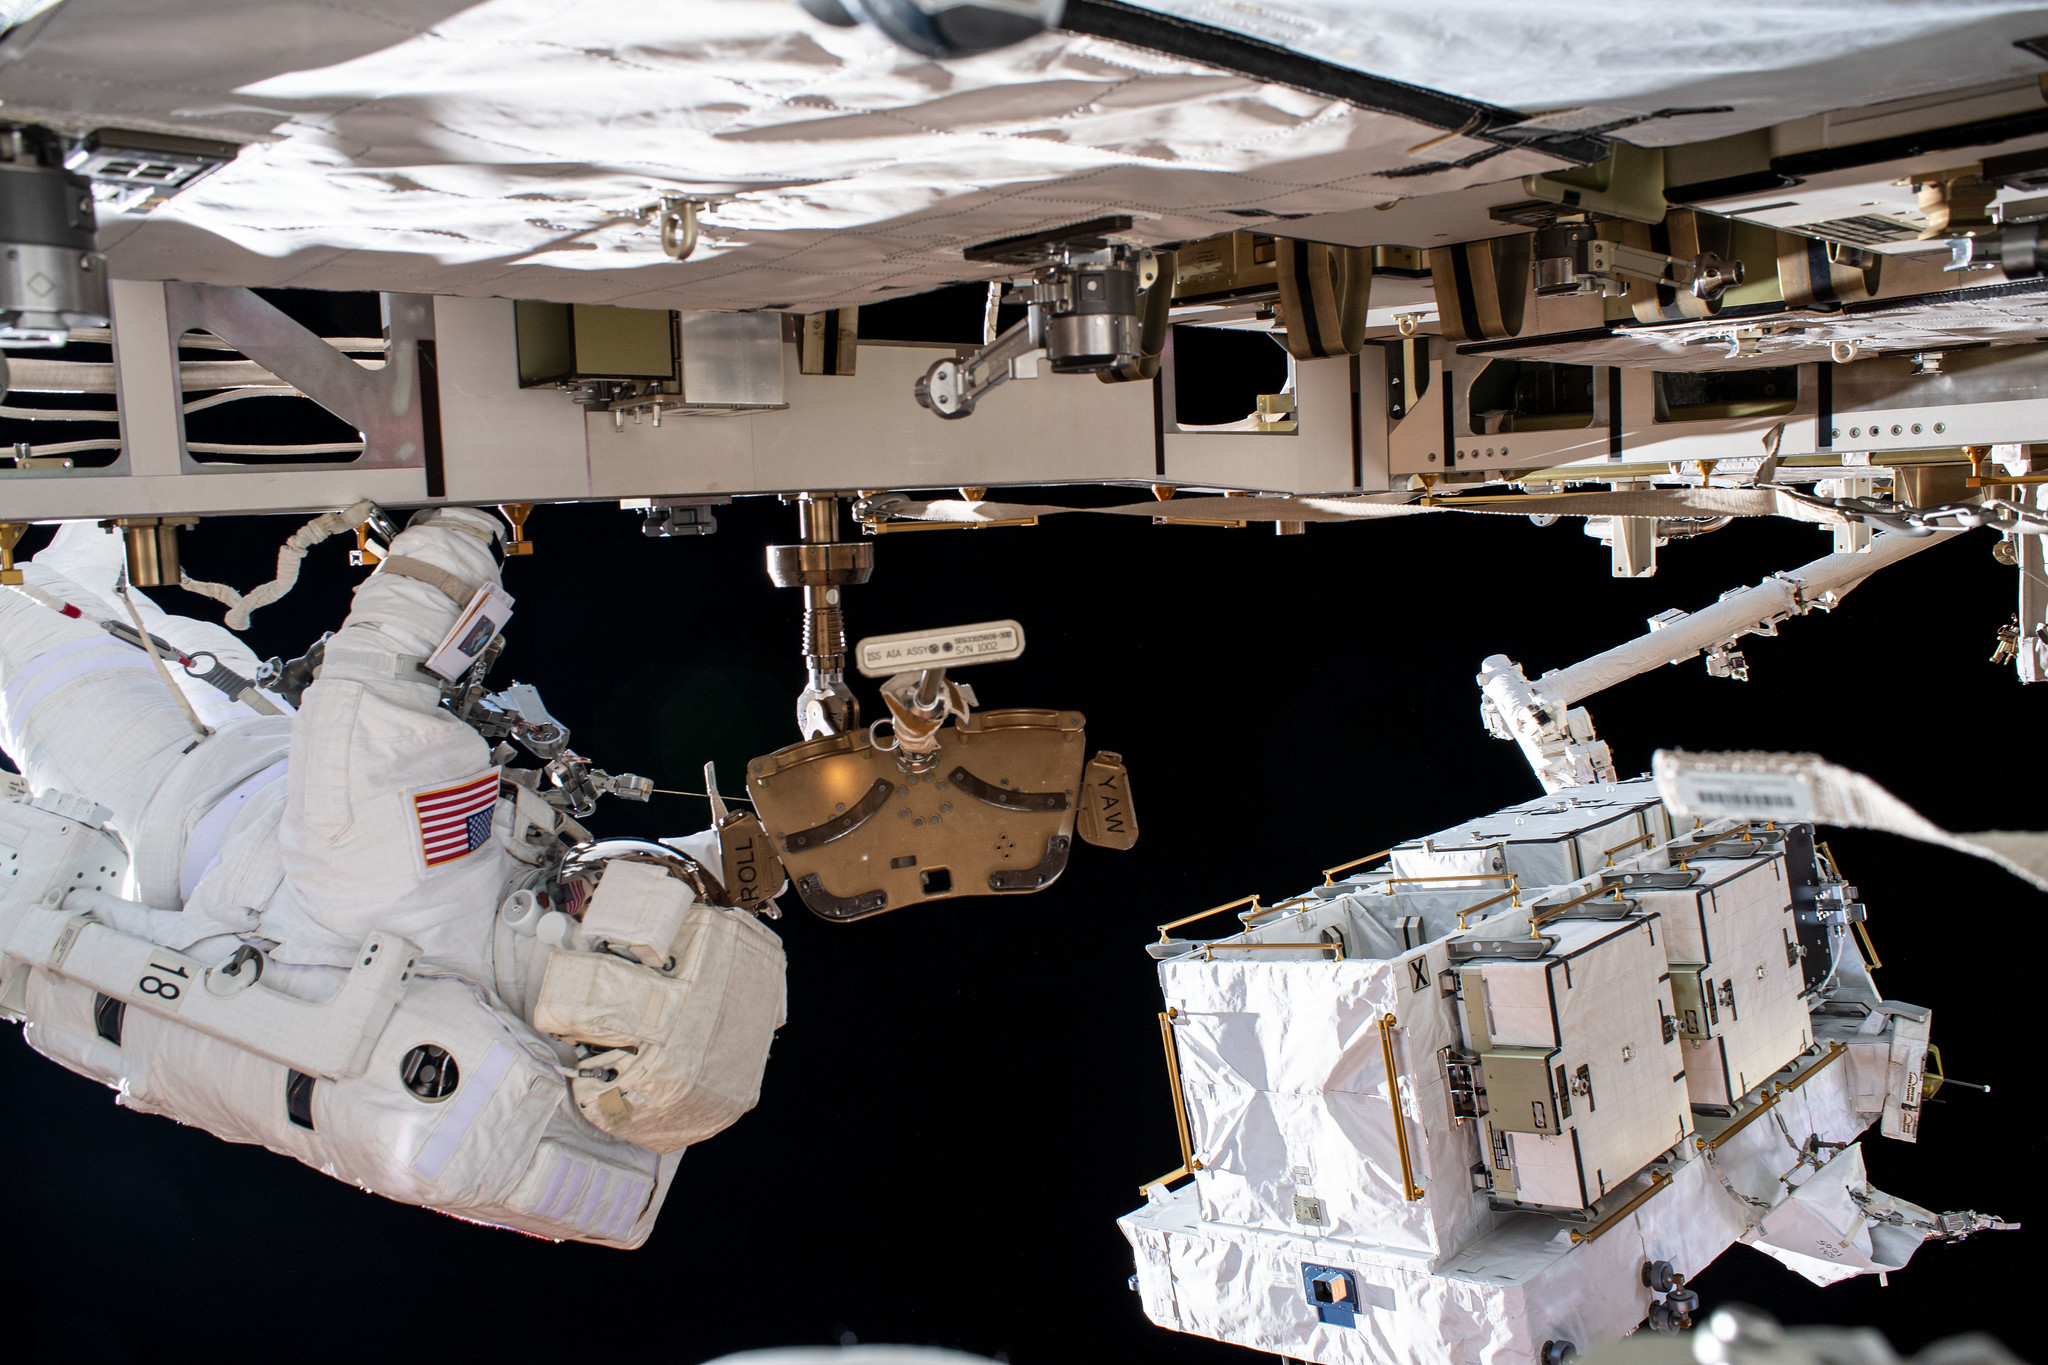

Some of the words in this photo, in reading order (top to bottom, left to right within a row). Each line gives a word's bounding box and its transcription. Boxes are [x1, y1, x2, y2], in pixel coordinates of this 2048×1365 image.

[867, 652, 881, 661] ISS
[886, 649, 902, 659] AIA
[906, 644, 929, 656] ASSY
[956, 644, 973, 655] S/N
[978, 642, 998, 652] 1002
[1098, 776, 1126, 833] YAW
[735, 837, 759, 902] ROLL
[139, 962, 190, 1000] 18
[1410, 957, 1429, 990] X
